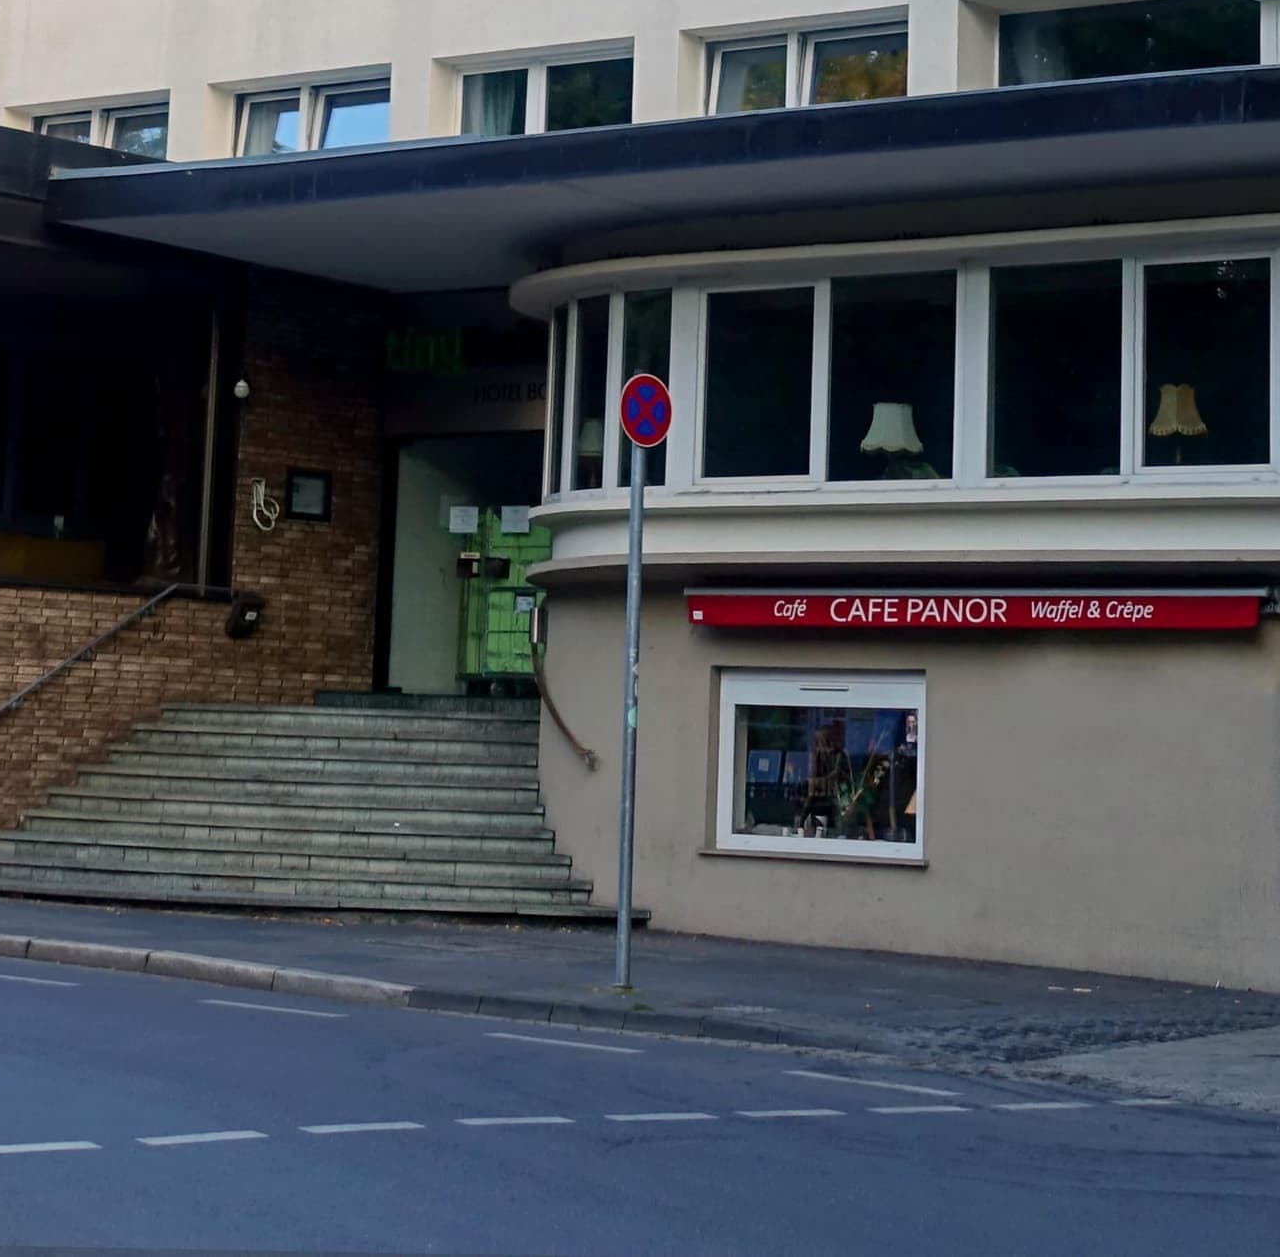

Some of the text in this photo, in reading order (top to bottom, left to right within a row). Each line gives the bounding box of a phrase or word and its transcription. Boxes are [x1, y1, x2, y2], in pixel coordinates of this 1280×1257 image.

[773, 598, 1154, 623] Café CAFE PANOR Waffel & Crêpe
